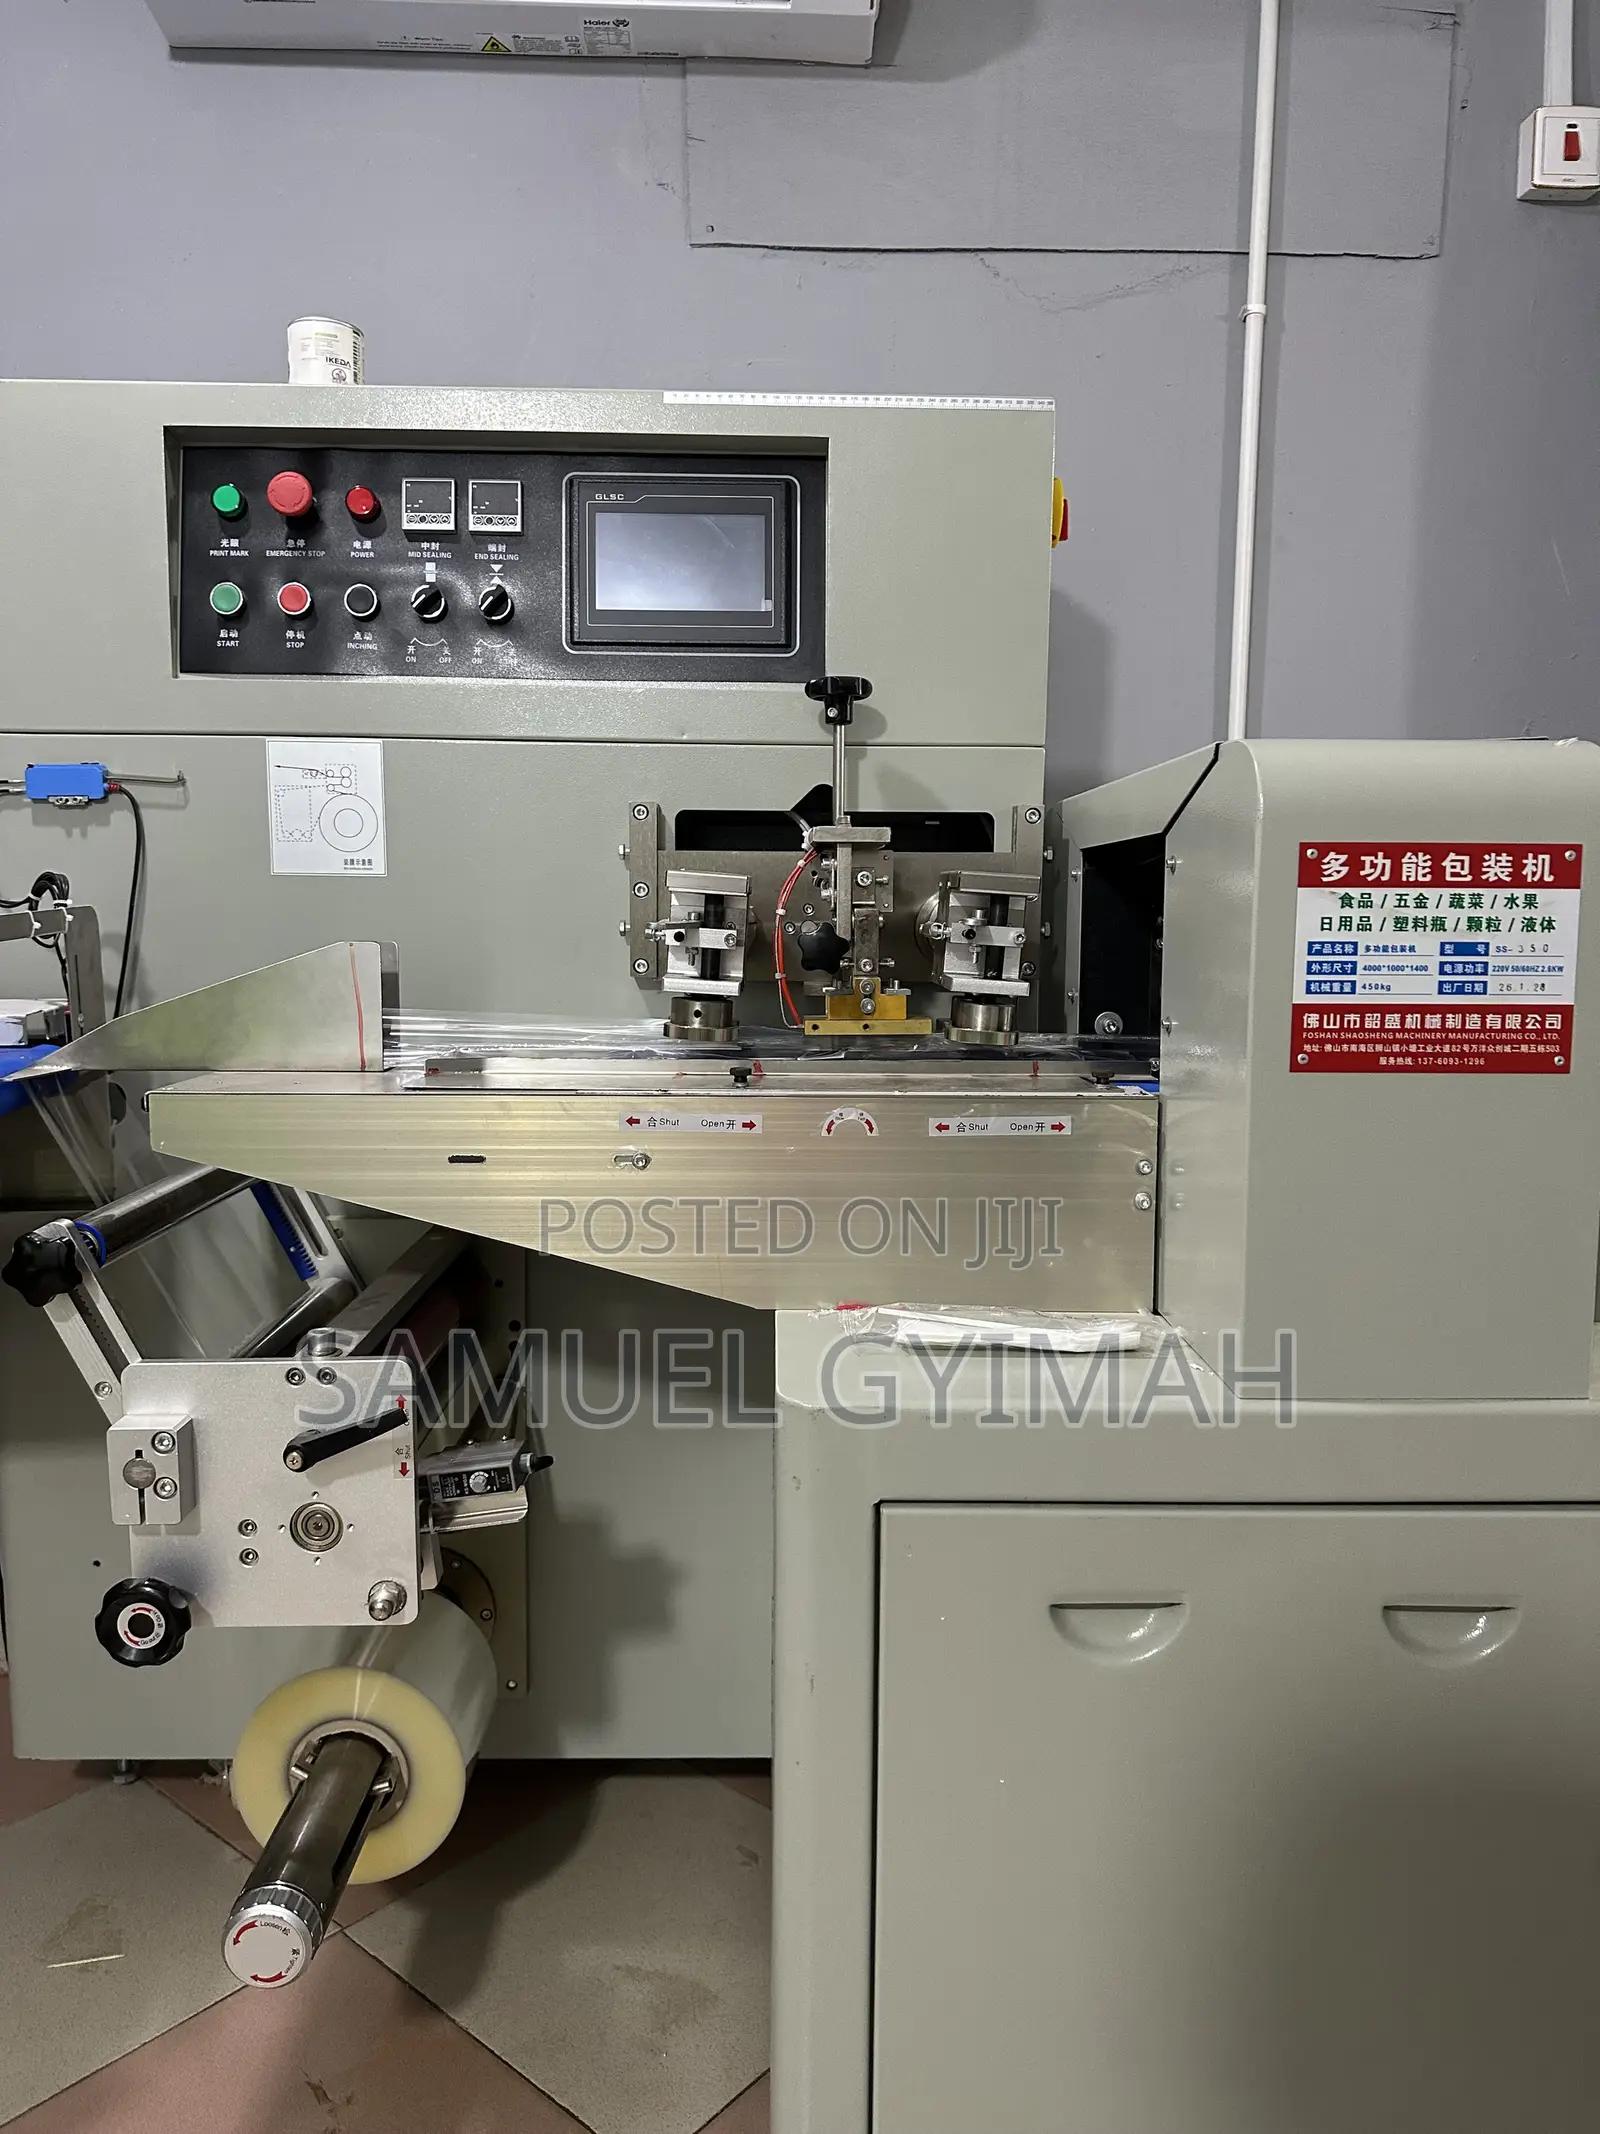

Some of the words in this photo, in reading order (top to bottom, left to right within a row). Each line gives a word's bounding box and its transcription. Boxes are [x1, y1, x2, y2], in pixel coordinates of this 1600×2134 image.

[325, 356, 352, 369] IKEDA
[595, 493, 625, 501] GLSC
[286, 539, 306, 548] 急停
[353, 540, 372, 549] 电源
[421, 542, 440, 551] 中封
[265, 550, 306, 558] EMERGENCY
[350, 551, 375, 559] POWER
[408, 551, 422, 559] MID
[423, 552, 452, 560] SEALING
[490, 554, 519, 562] SEALING
[219, 628, 239, 639] 启动
[285, 629, 306, 640] 停机
[353, 631, 373, 641] 点动
[216, 640, 240, 648] START
[286, 641, 305, 649] STOP
[347, 642, 378, 651] INCHING
[407, 645, 416, 655] 开
[473, 646, 482, 656] 开
[405, 655, 417, 663] ON
[472, 657, 483, 665] ON
[1320, 851, 1555, 883] 多功能包装机
[1311, 943, 1355, 954] 产品名称
[1364, 944, 1417, 953] 多功能包装机
[1310, 962, 1354, 973] 外形尺寸
[1443, 963, 1485, 974] 电源功率
[1492, 965, 1510, 973] 220V
[1310, 982, 1352, 993] 机械重量
[1361, 983, 1391, 991] 450kg
[1442, 982, 1484, 993] 出厂日期
[1303, 1013, 1562, 1030] 佛山市韶盛机械制造有限公司
[1395, 1032, 1446, 1040] MACHINERY
[1418, 1057, 1485, 1066] 137-6093-1296
[647, 1116, 658, 1128] 合
[659, 1117, 680, 1126] Shut
[700, 1119, 725, 1128] Open
[726, 1119, 736, 1130] 开
[956, 1122, 967, 1133] 合
[968, 1123, 989, 1131] Shut
[1009, 1122, 1034, 1131] Open
[1034, 1121, 1046, 1132] 开
[404, 1444, 412, 1460] Shut
[259, 1921, 284, 1931] Loosen
